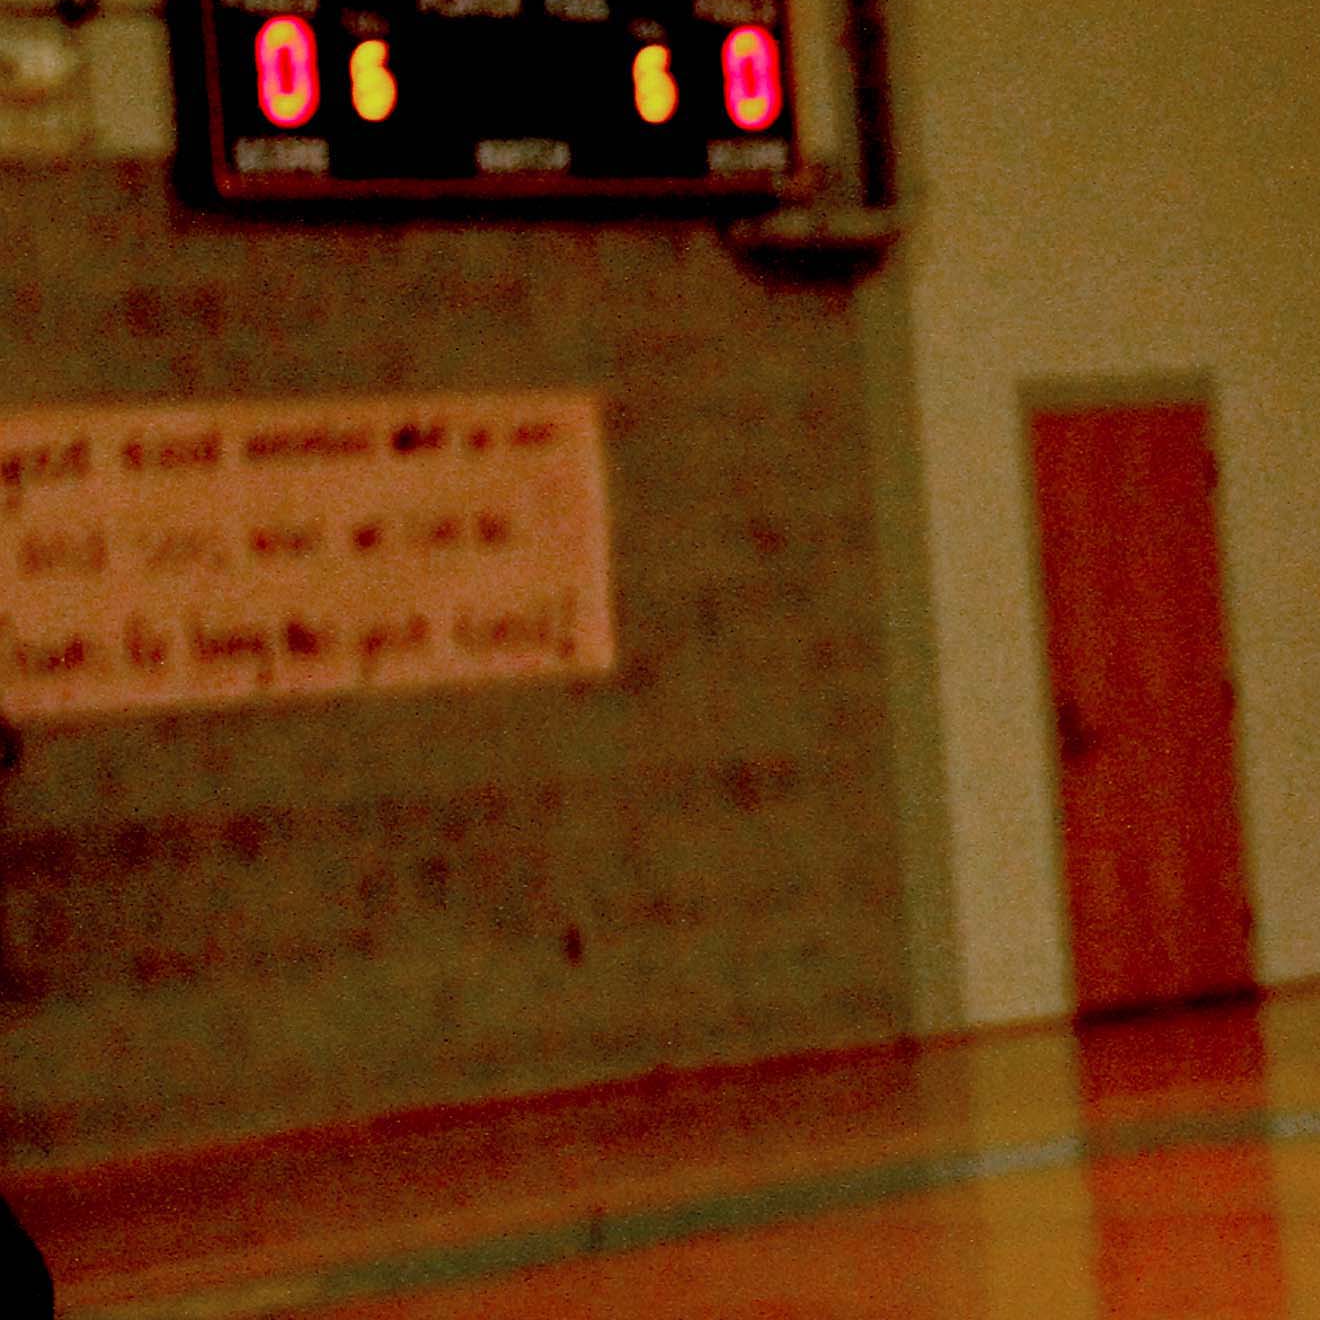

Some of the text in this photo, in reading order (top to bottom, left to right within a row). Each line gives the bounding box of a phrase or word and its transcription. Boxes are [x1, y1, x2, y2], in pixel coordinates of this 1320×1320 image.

[255, 15, 319, 129] 0
[350, 40, 397, 122] 6
[632, 44, 679, 124] 6
[721, 25, 782, 132] 0
